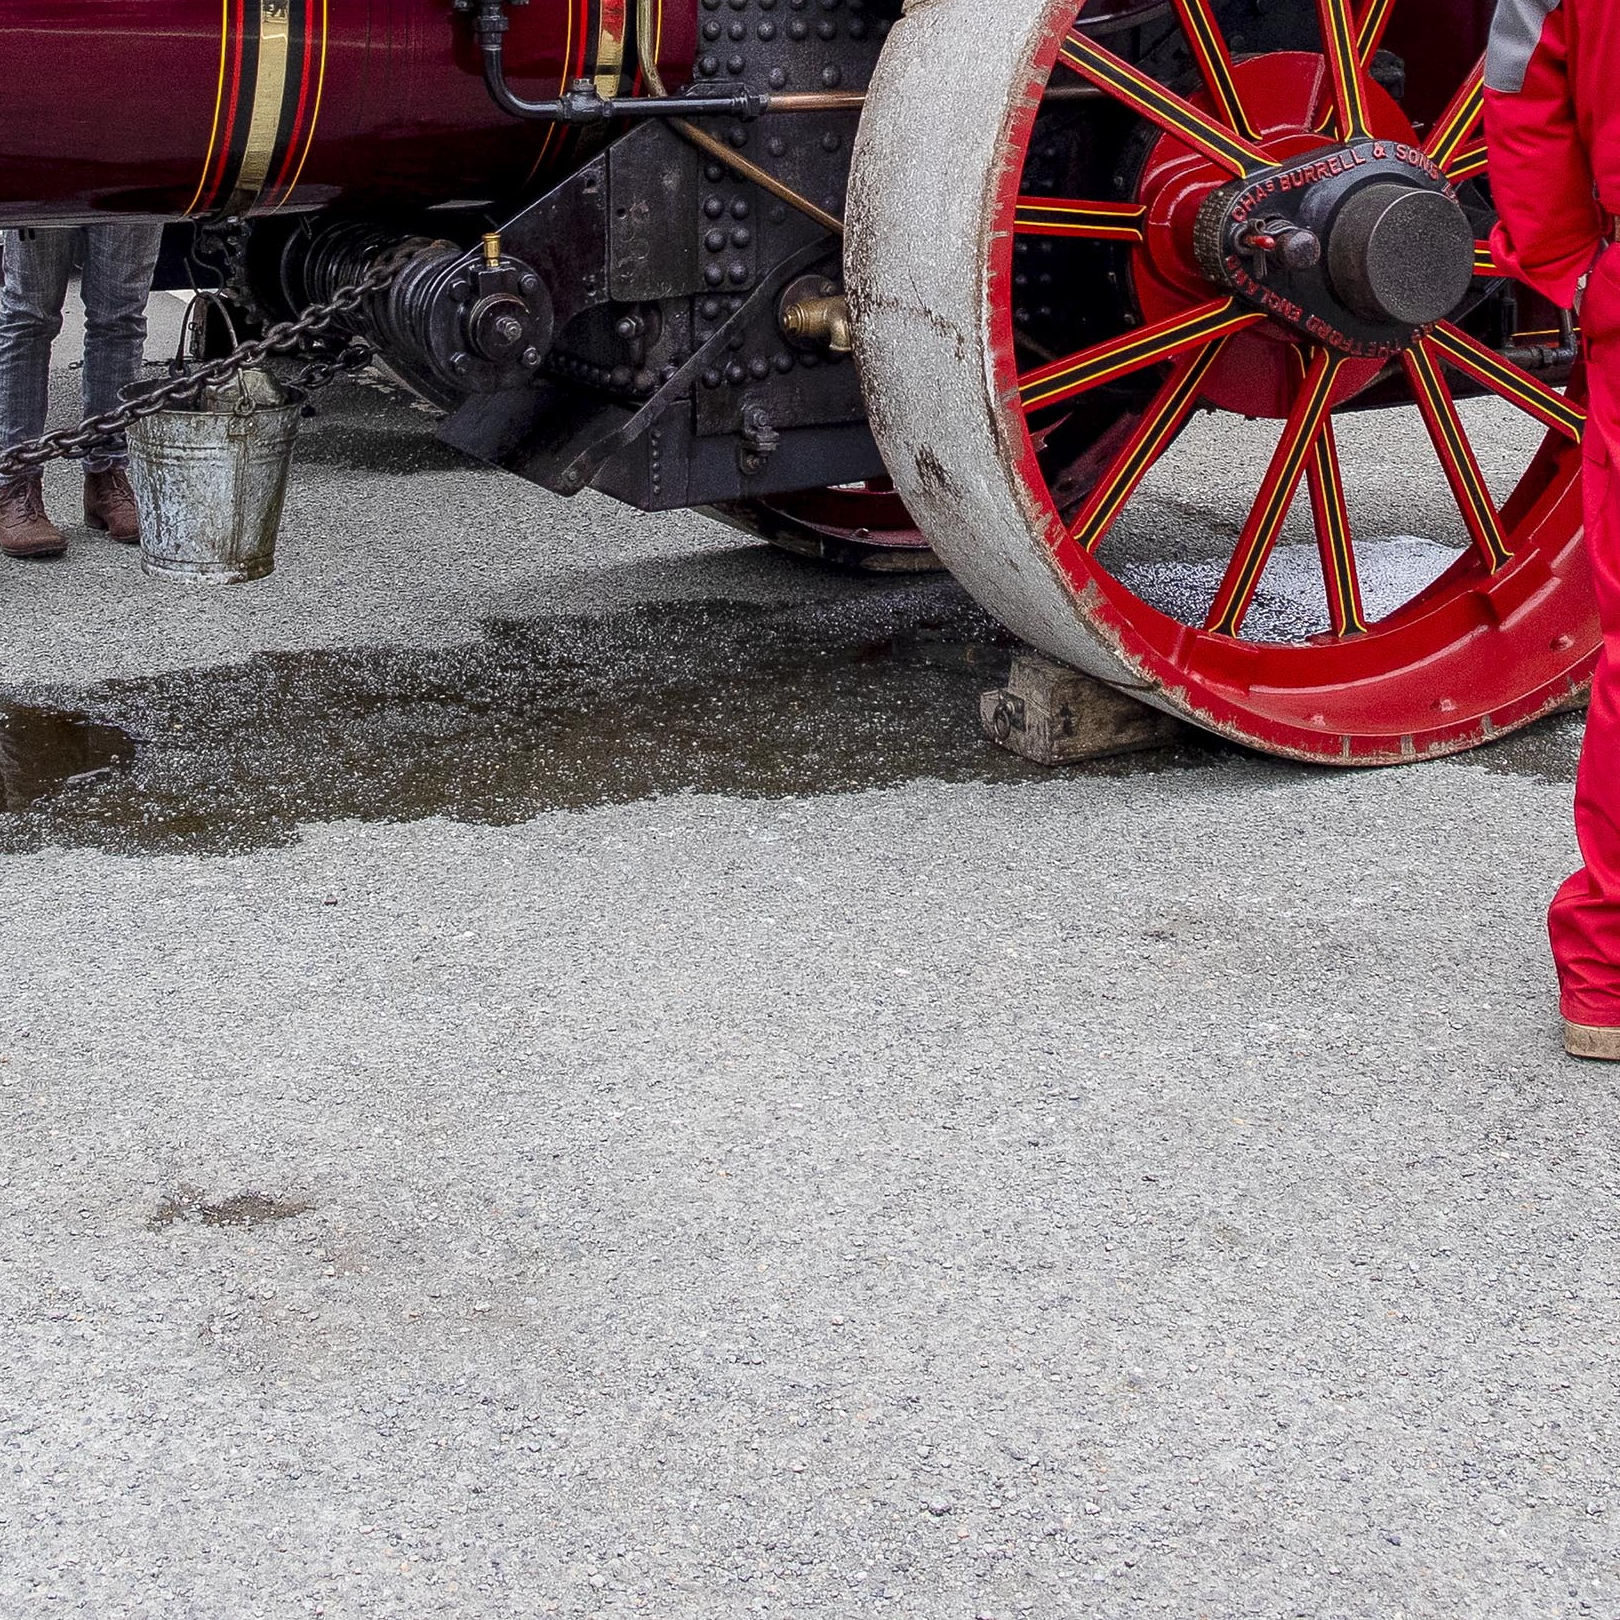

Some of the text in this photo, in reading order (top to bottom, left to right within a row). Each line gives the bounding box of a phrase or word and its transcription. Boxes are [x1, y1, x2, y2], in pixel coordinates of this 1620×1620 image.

[1277, 147, 1367, 192] BURRELL
[1372, 141, 1389, 160] &
[1395, 143, 1439, 180] SONS
